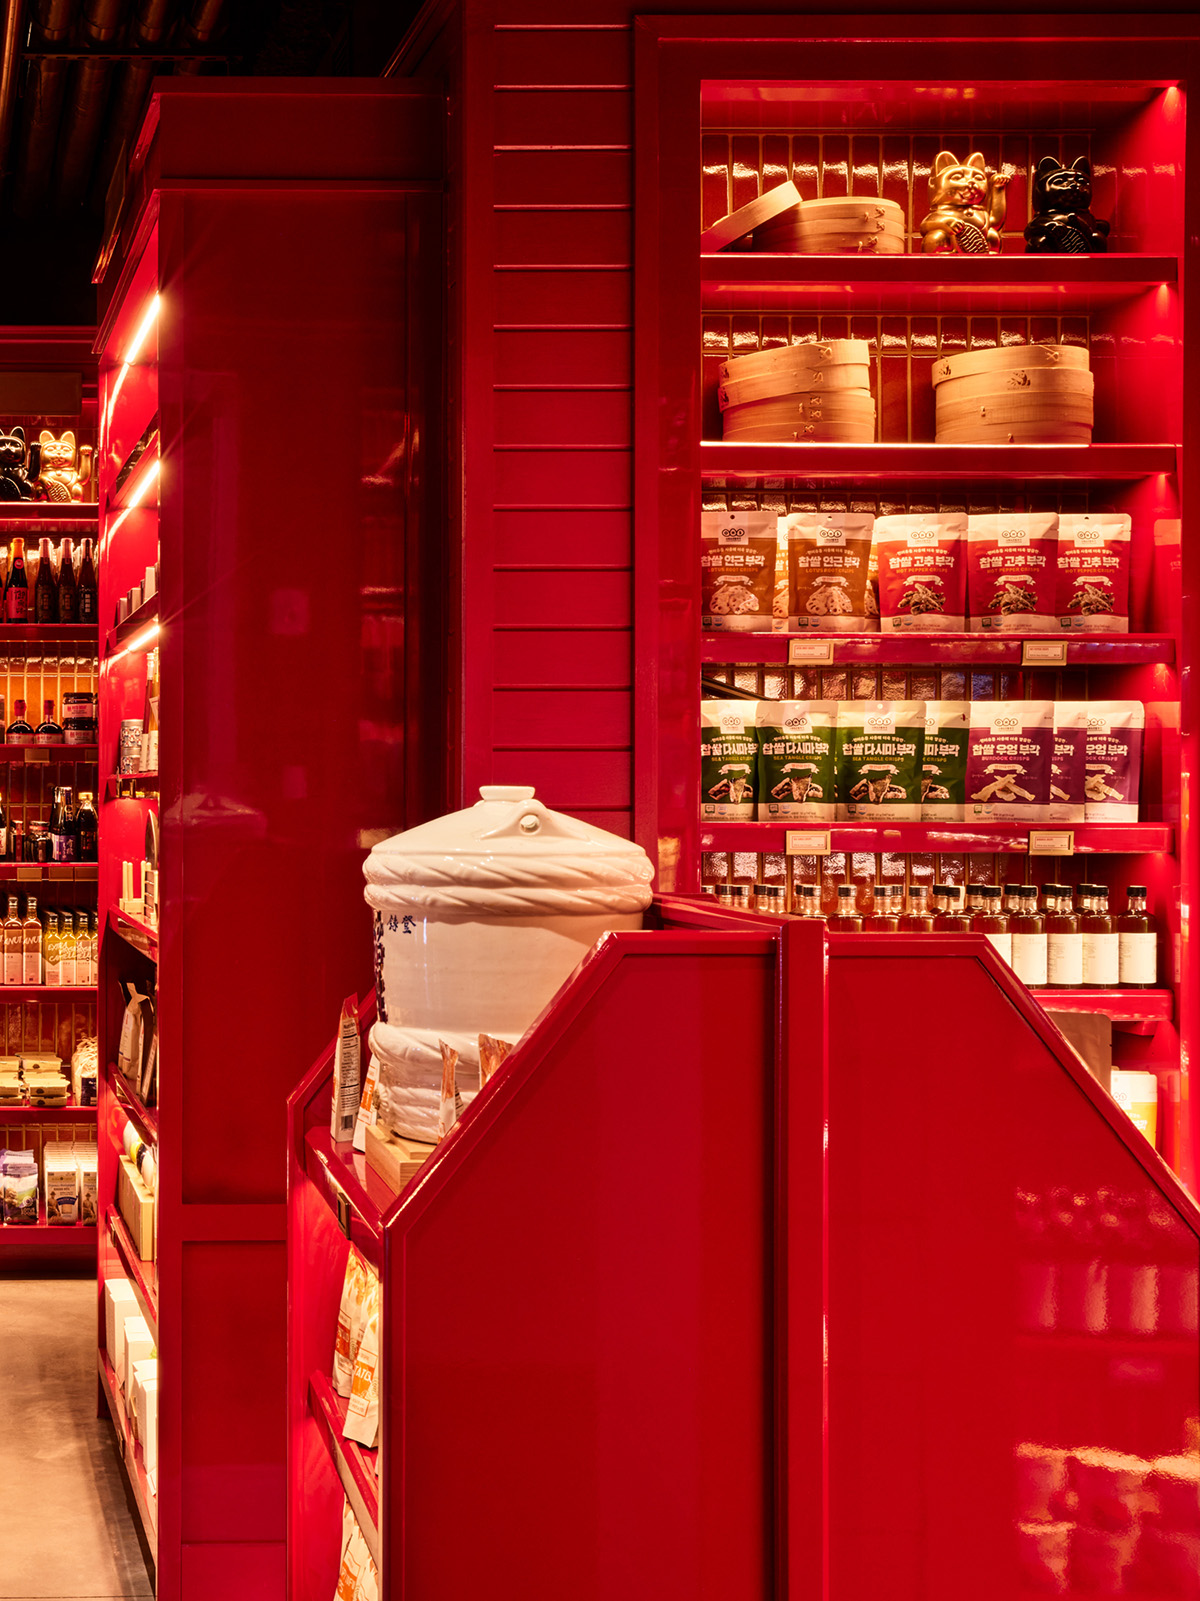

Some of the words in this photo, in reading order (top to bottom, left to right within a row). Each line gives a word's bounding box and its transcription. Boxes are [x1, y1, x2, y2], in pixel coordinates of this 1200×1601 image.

[724, 555, 744, 567] 연근
[745, 554, 765, 567] 부각
[798, 556, 821, 568] 찹쌀
[823, 556, 842, 567] 연근
[844, 556, 860, 569] 부각
[889, 556, 912, 569] 찹쌀
[914, 556, 934, 568] 고추
[935, 555, 955, 568] 부각
[979, 556, 1003, 569] 찹쌀
[1004, 556, 1026, 567] 고추
[1026, 555, 1046, 568] 부각
[1057, 556, 1080, 569] 찹쌀
[1081, 556, 1101, 568] 고추
[1102, 556, 1120, 569] 부각
[763, 743, 785, 756] 찹쌀
[786, 743, 814, 754] 다시마
[815, 743, 829, 756] 부각
[842, 743, 864, 756] 찹쌀
[864, 743, 896, 755] 다시마
[896, 743, 916, 757] 부각
[939, 744, 960, 757] 부각
[972, 744, 995, 757] 찹쌀
[996, 744, 1018, 756] 우엉
[1019, 744, 1040, 757] 부각
[1054, 744, 1074, 757] 부각
[1108, 744, 1128, 757] 부각
